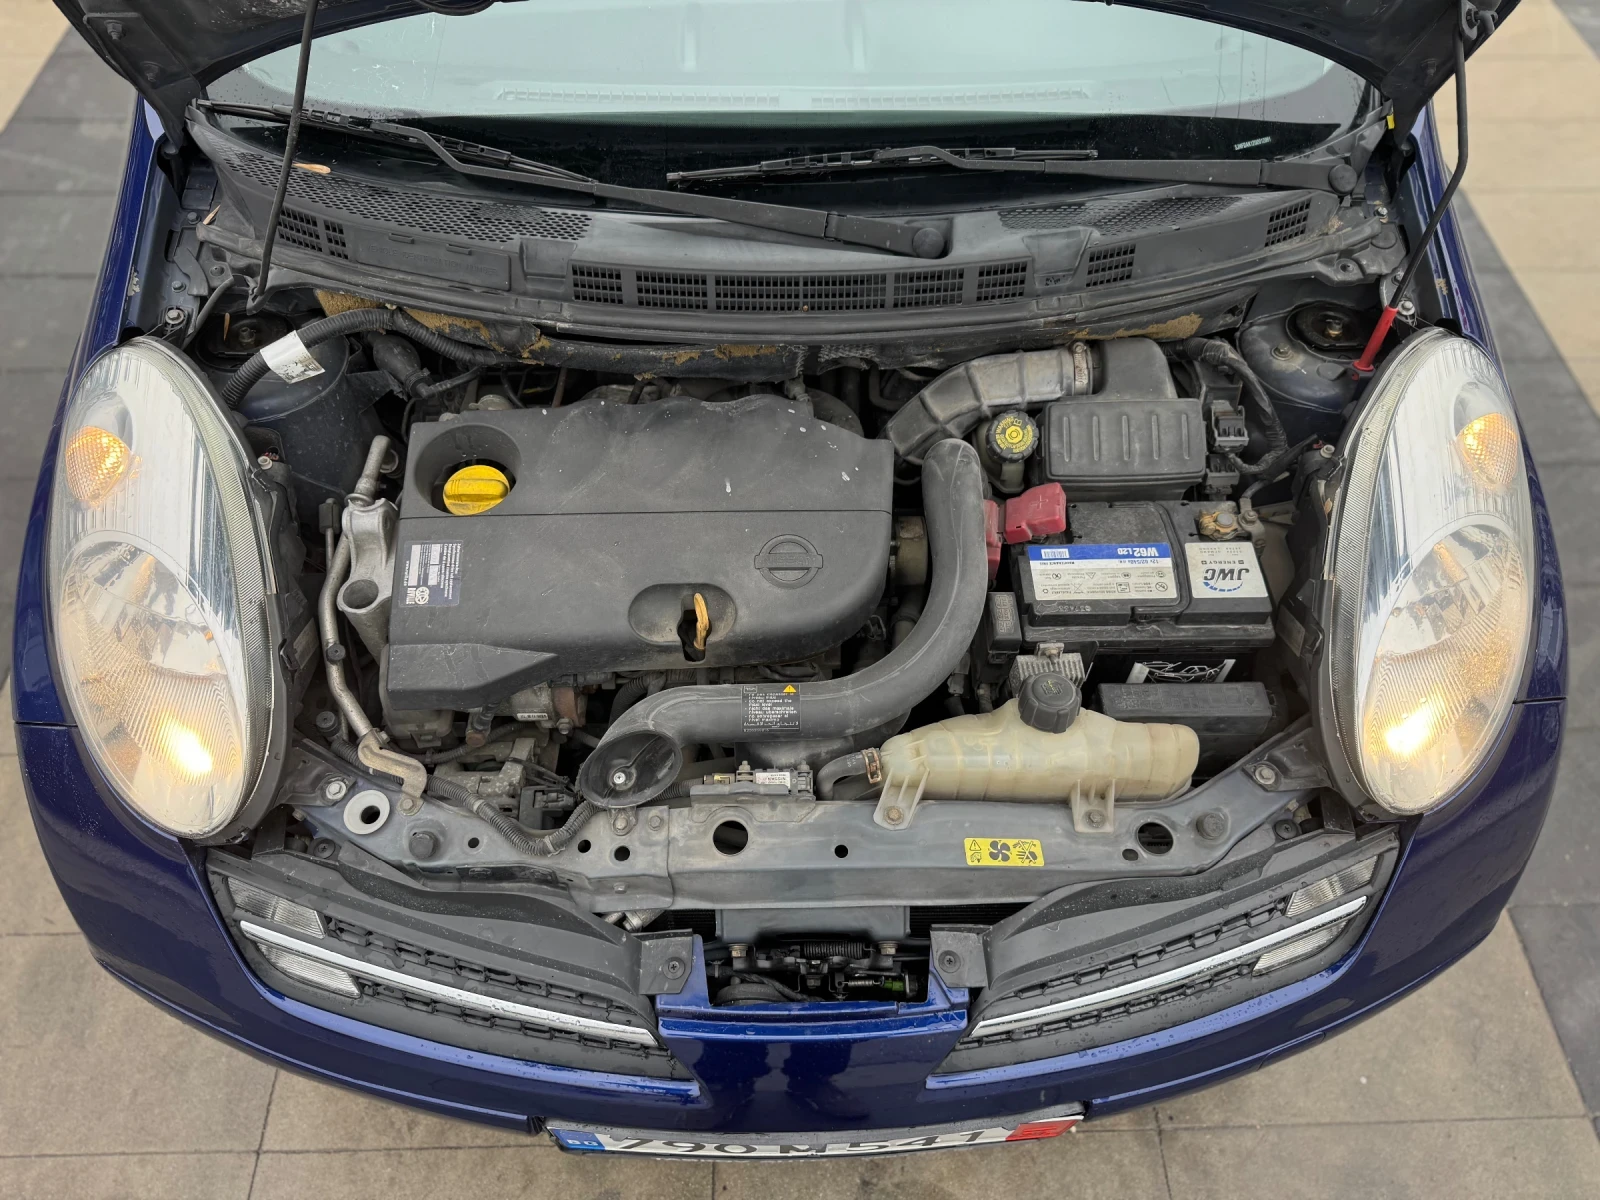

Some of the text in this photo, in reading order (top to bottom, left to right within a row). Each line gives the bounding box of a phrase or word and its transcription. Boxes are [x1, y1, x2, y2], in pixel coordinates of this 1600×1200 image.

[368, 245, 497, 276] VEHICLE IDENTIFICATION NUMBER
[1133, 547, 1159, 557] W62
[1203, 568, 1250, 582] JWC
[621, 1130, 985, 1154] 790 M 541
